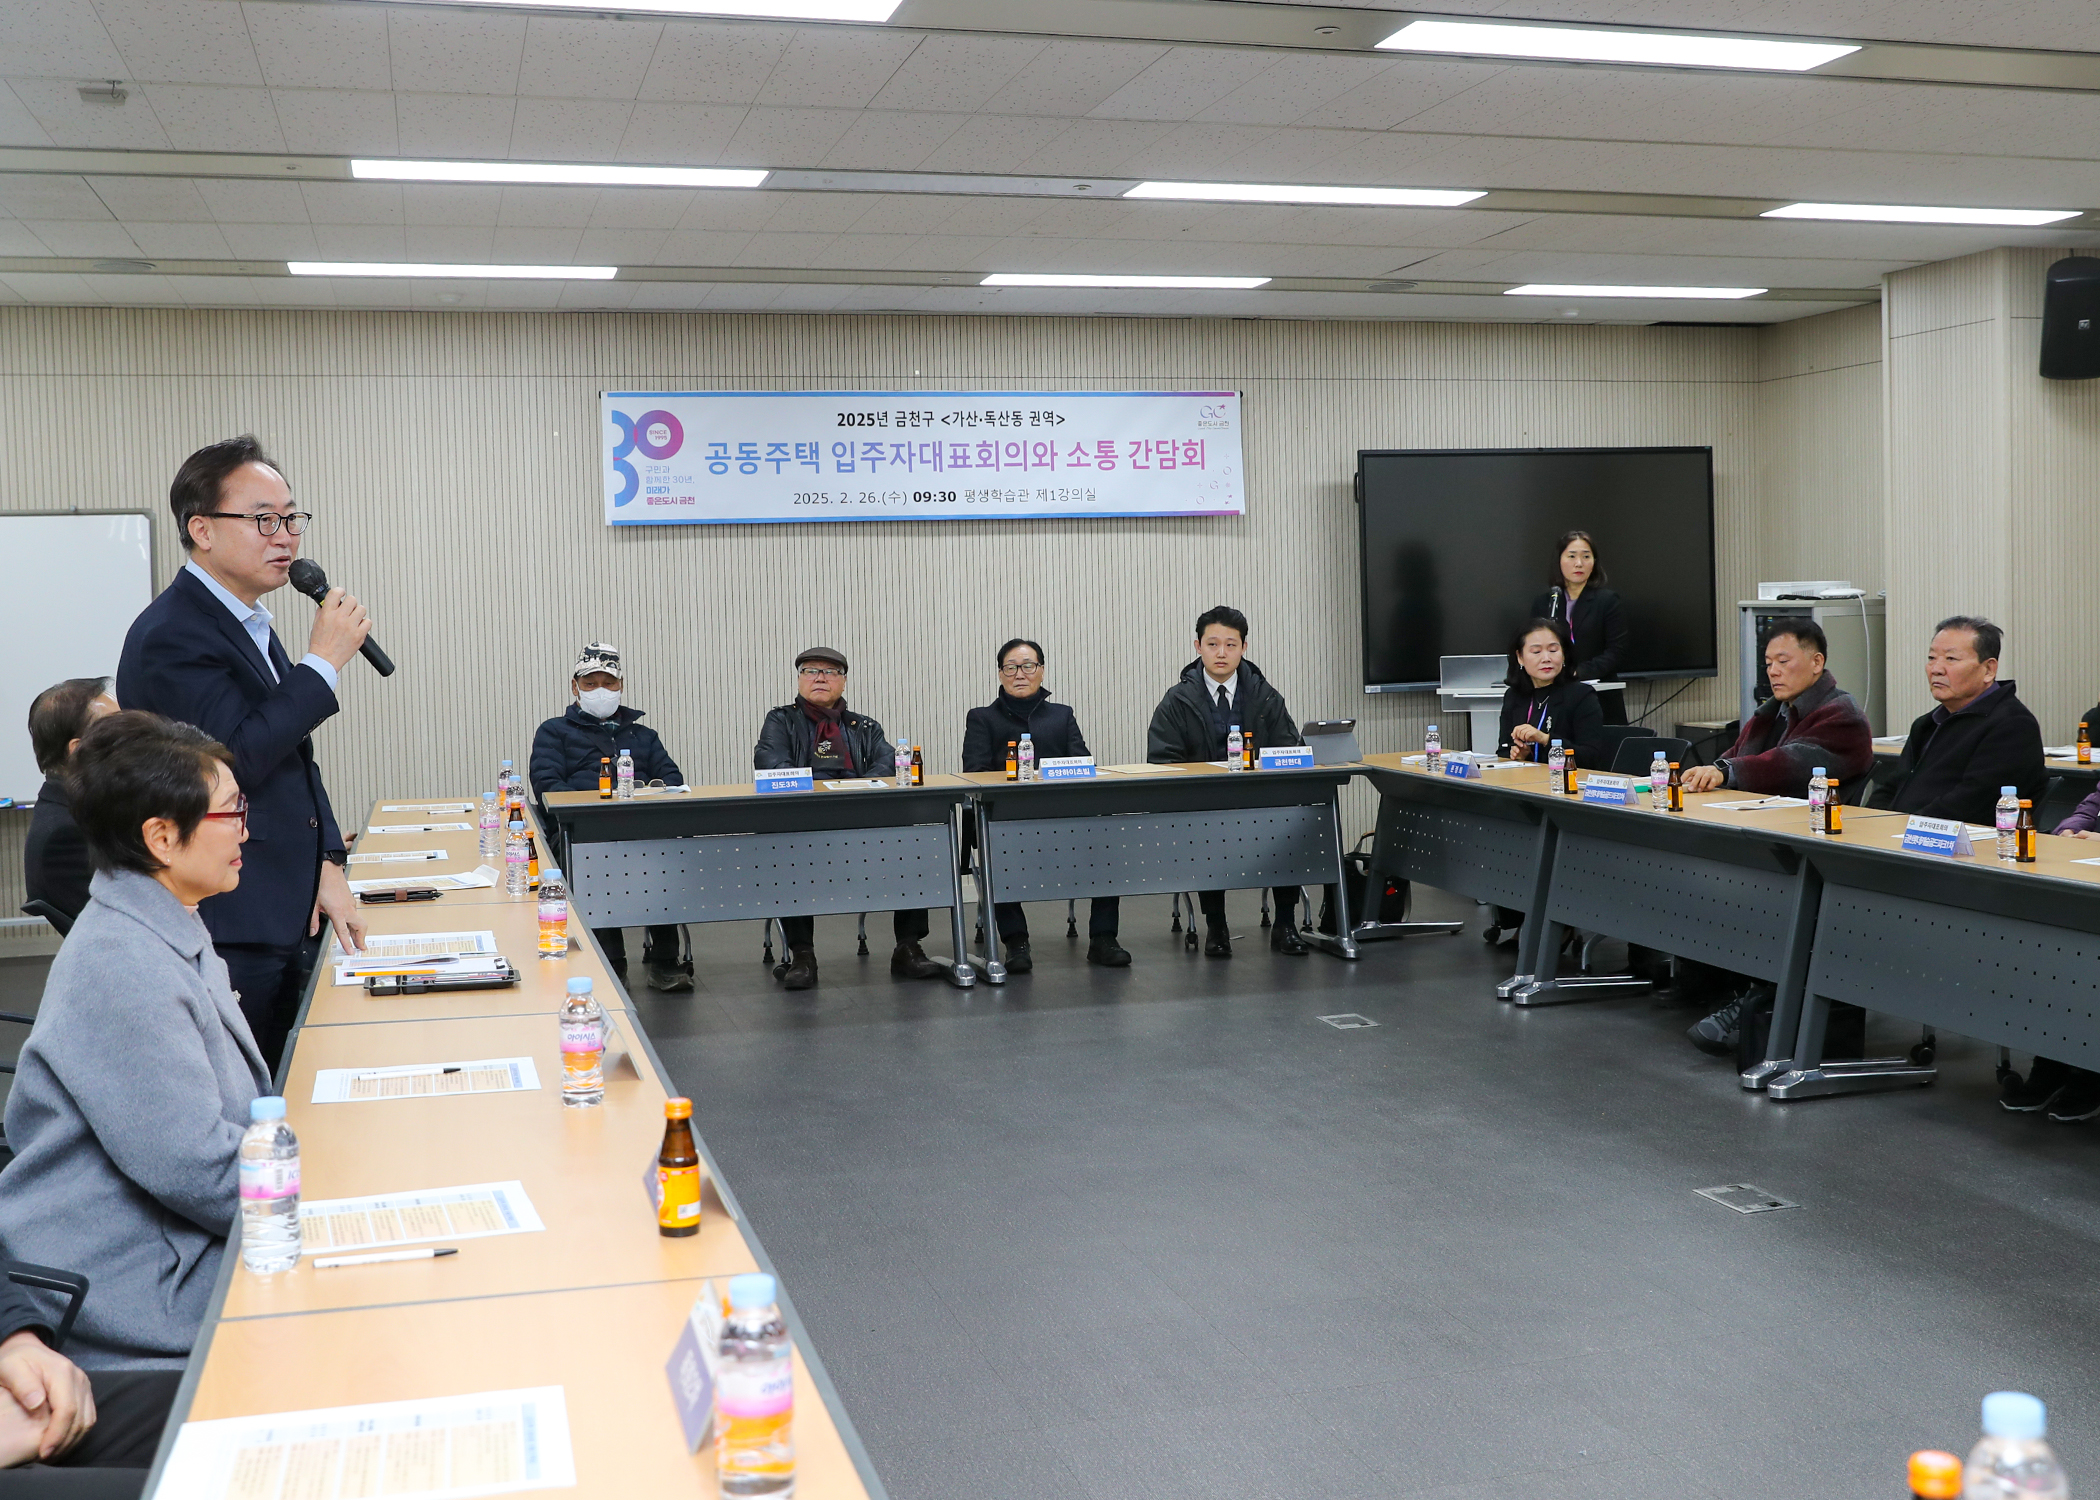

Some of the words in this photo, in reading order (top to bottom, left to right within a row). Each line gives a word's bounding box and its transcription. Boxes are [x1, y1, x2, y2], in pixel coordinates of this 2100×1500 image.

[837, 410, 889, 428] 2025년
[894, 410, 935, 428] 금천구
[1028, 410, 1066, 427] 권역>
[705, 441, 820, 475] 공동주택
[831, 440, 1059, 474] 입주자대표회의와
[1066, 439, 1119, 471] 소통
[1128, 438, 1206, 470] 간담회
[645, 465, 670, 474] 구민과
[646, 475, 671, 484] 함께한
[646, 486, 670, 494] 미래가
[647, 497, 677, 505] 좋은도시
[679, 496, 695, 505] 금천
[793, 492, 834, 505] 2025.
[840, 492, 853, 504] 2.
[912, 491, 957, 503] 09:30
[964, 489, 1030, 502] 평생학습관
[1036, 488, 1097, 502] 제1강의실
[771, 780, 799, 790] 진도3차
